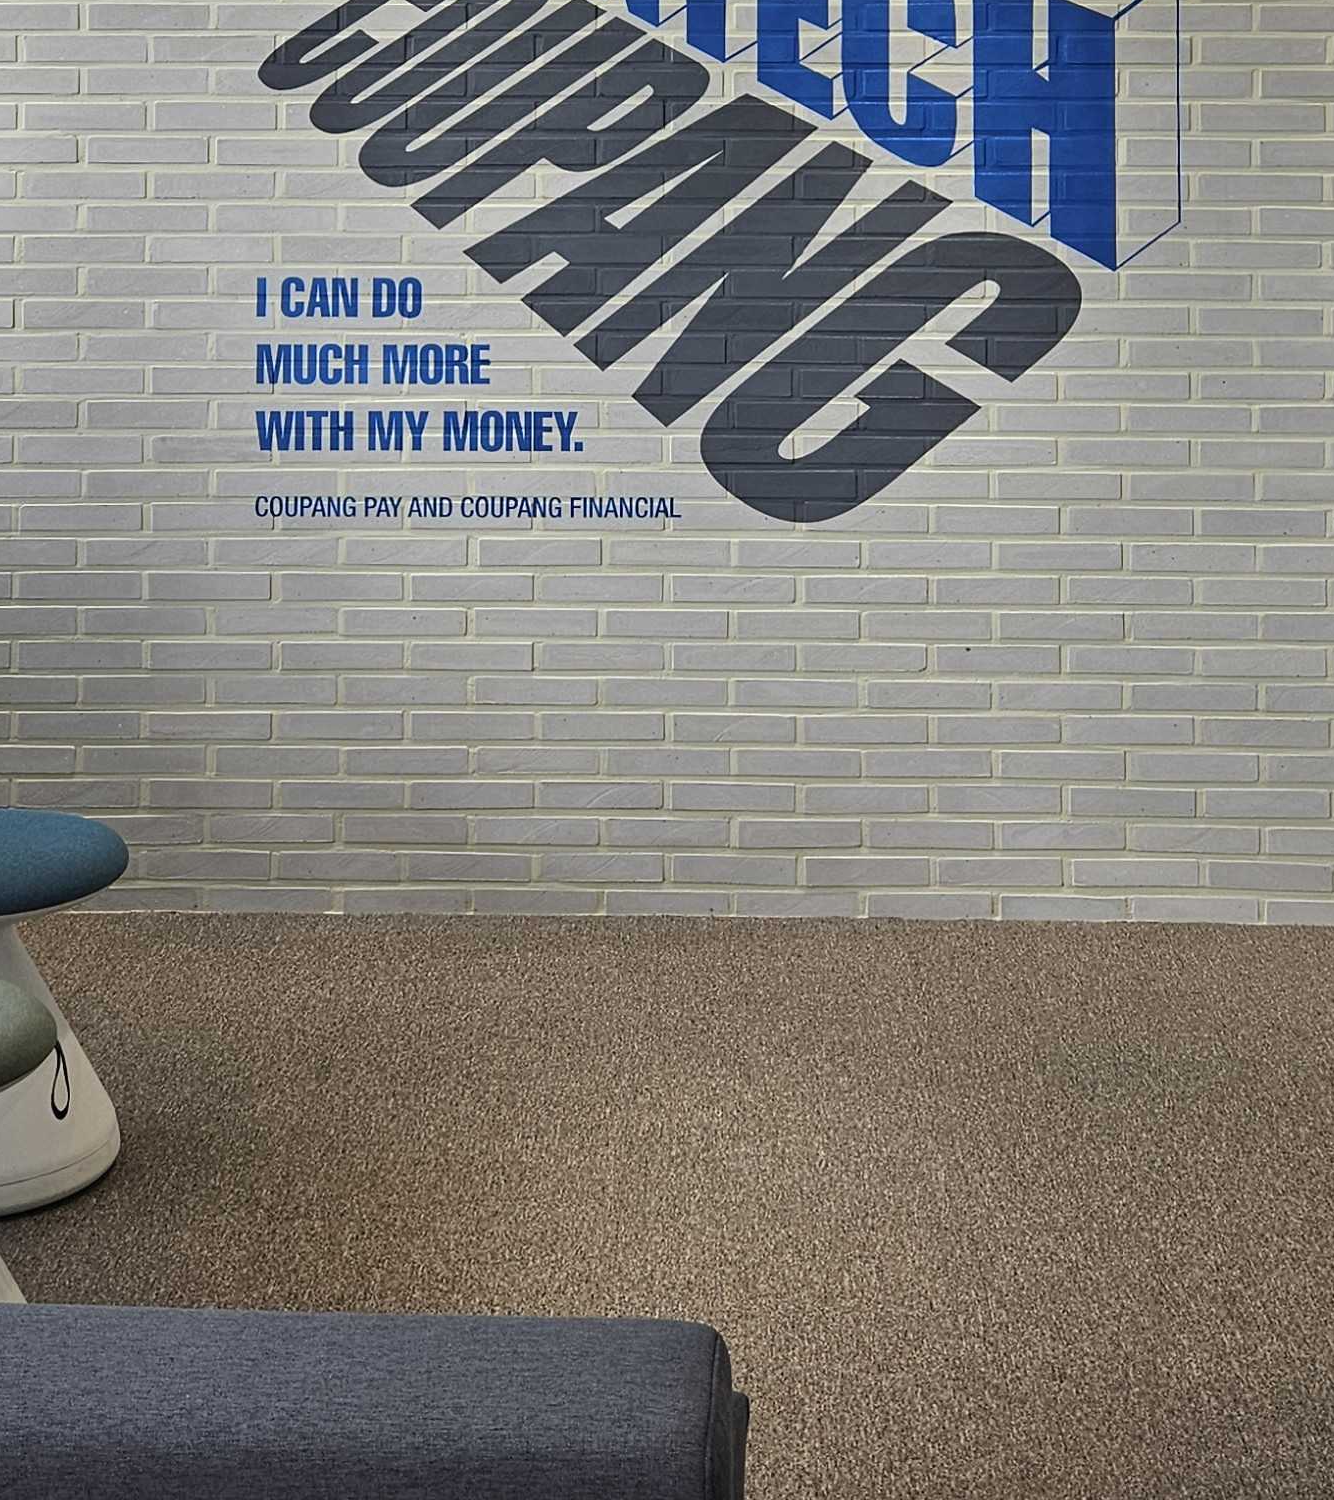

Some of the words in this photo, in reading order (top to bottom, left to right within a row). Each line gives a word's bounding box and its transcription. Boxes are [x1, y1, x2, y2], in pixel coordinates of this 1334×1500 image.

[256, 277, 267, 318] I
[281, 276, 359, 319] CAN
[372, 276, 423, 319] DO
[256, 343, 368, 386] MUCH
[383, 343, 491, 386] MORE
[256, 410, 354, 452] WITH
[367, 410, 429, 452] MY
[443, 410, 584, 452] MONEY.
[255, 496, 356, 518] COUPANG
[364, 496, 402, 518] PAY
[408, 496, 452, 518] AND
[460, 496, 562, 518] COUPANG
[569, 496, 682, 519] FINANCIAL
